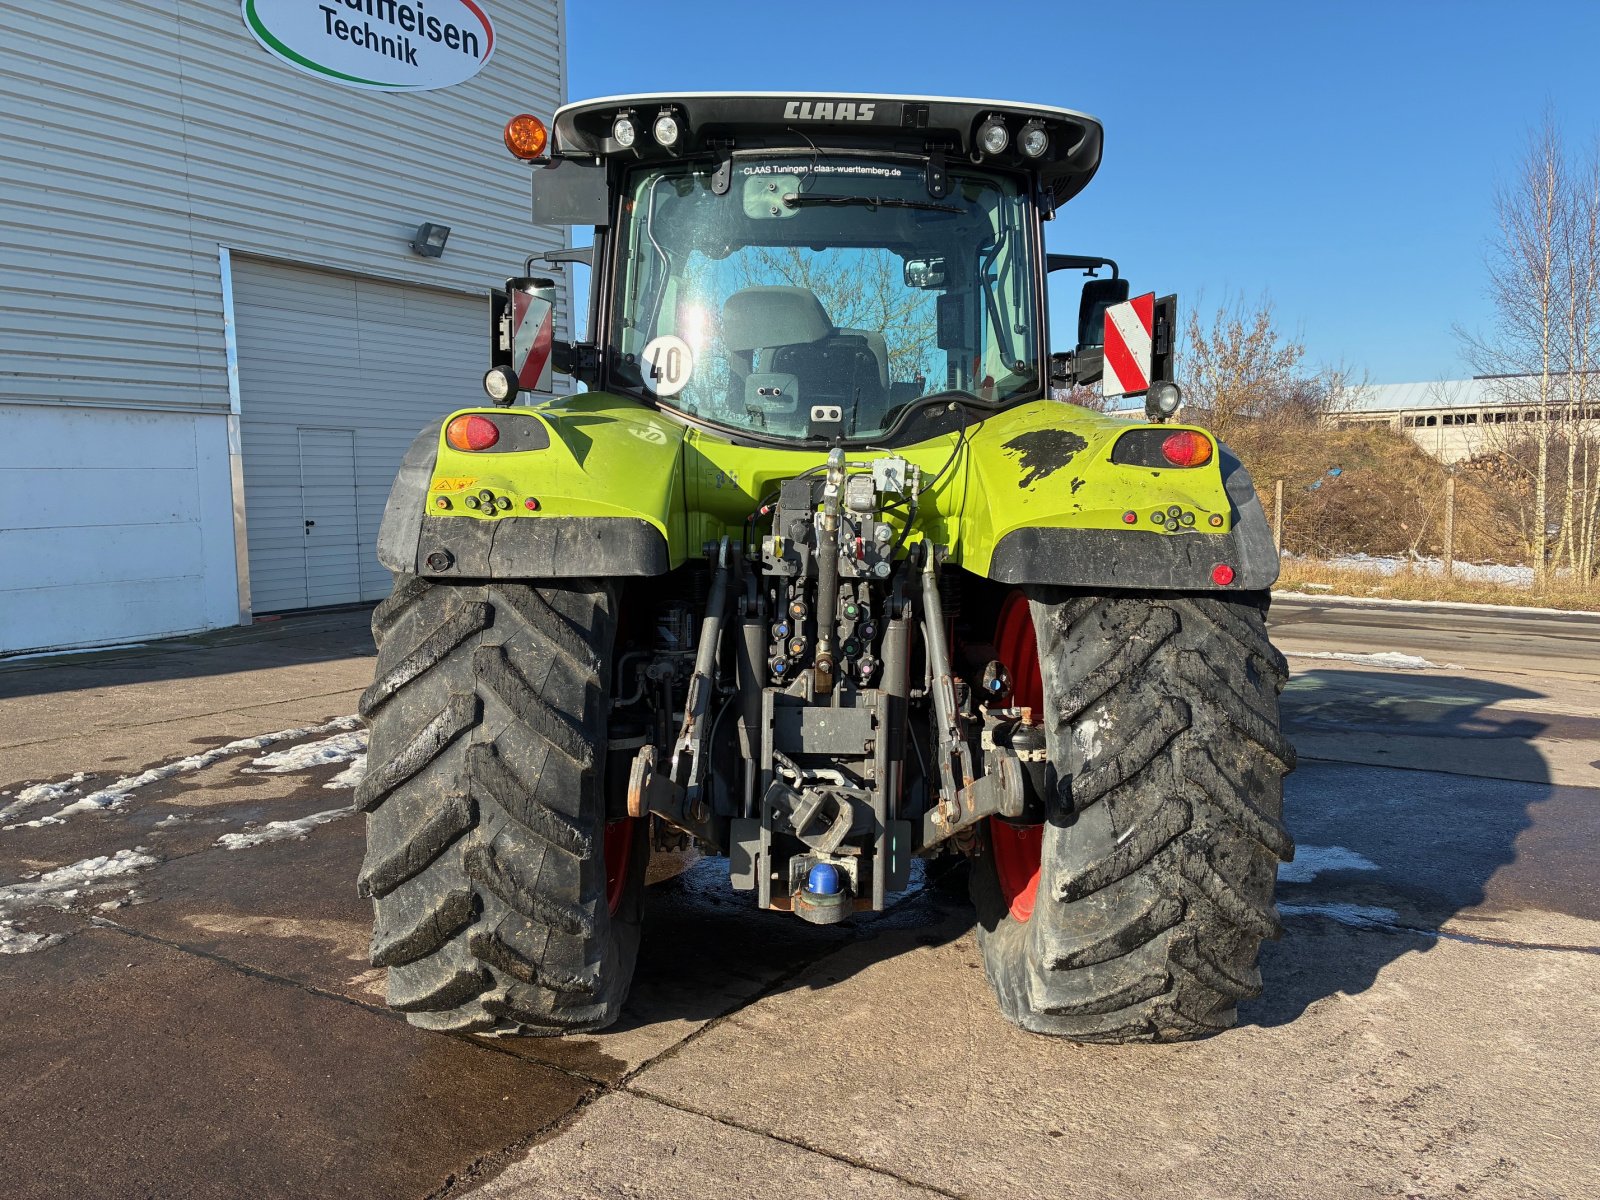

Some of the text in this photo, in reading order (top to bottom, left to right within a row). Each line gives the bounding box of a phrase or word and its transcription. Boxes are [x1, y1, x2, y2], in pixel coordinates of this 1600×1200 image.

[319, 5, 419, 67] Technik
[334, 0, 479, 58] ffeisen
[783, 101, 876, 121] CLAAS
[773, 165, 808, 174] Tuningen
[814, 165, 902, 177] claas-wuerttemberg.de
[650, 346, 681, 384] 40
